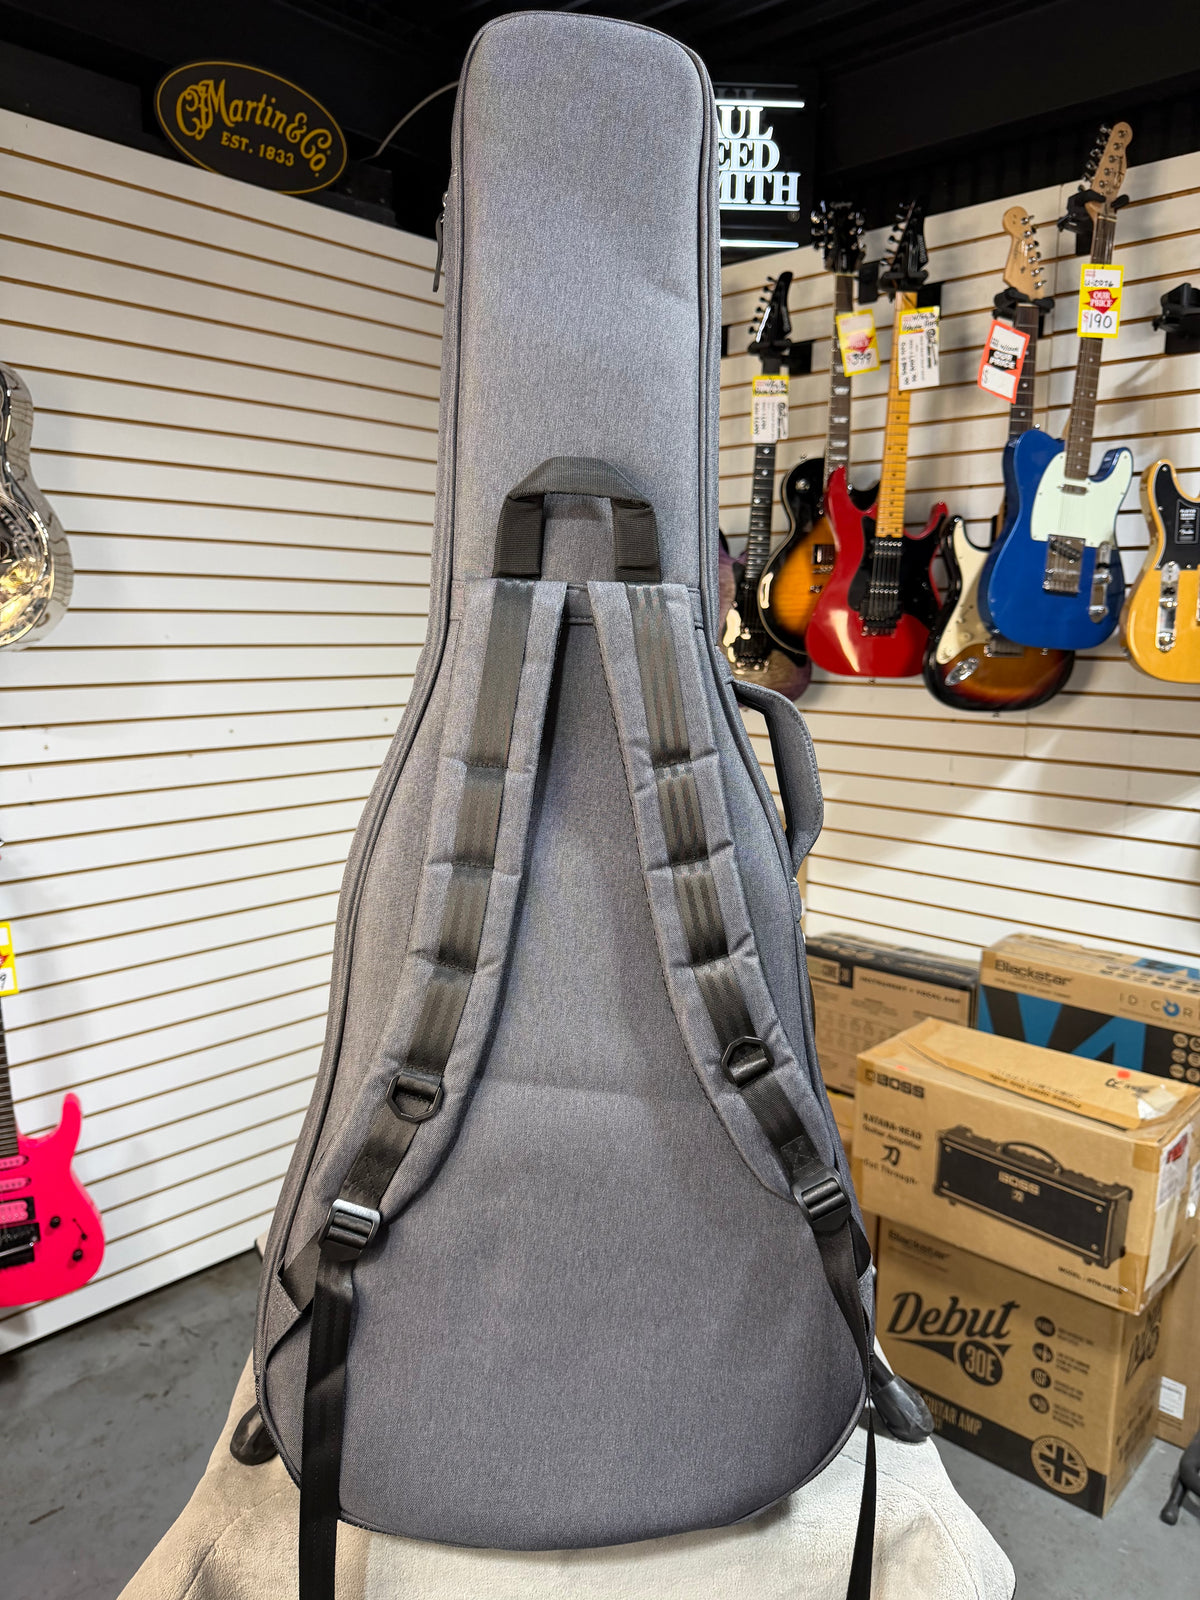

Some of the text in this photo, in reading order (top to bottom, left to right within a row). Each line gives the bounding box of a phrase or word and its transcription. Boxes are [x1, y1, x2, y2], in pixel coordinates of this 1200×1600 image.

[717, 105, 774, 140] UL
[221, 131, 294, 168] EST. 1833
[718, 138, 781, 172] EED
[994, 958, 1073, 987] Blackstar
[876, 1073, 925, 1099] BOSS
[998, 1171, 1042, 1197] BOSS
[887, 1292, 1023, 1340] Debut
[963, 1346, 997, 1382] 30E
[958, 1412, 983, 1436] AMP
